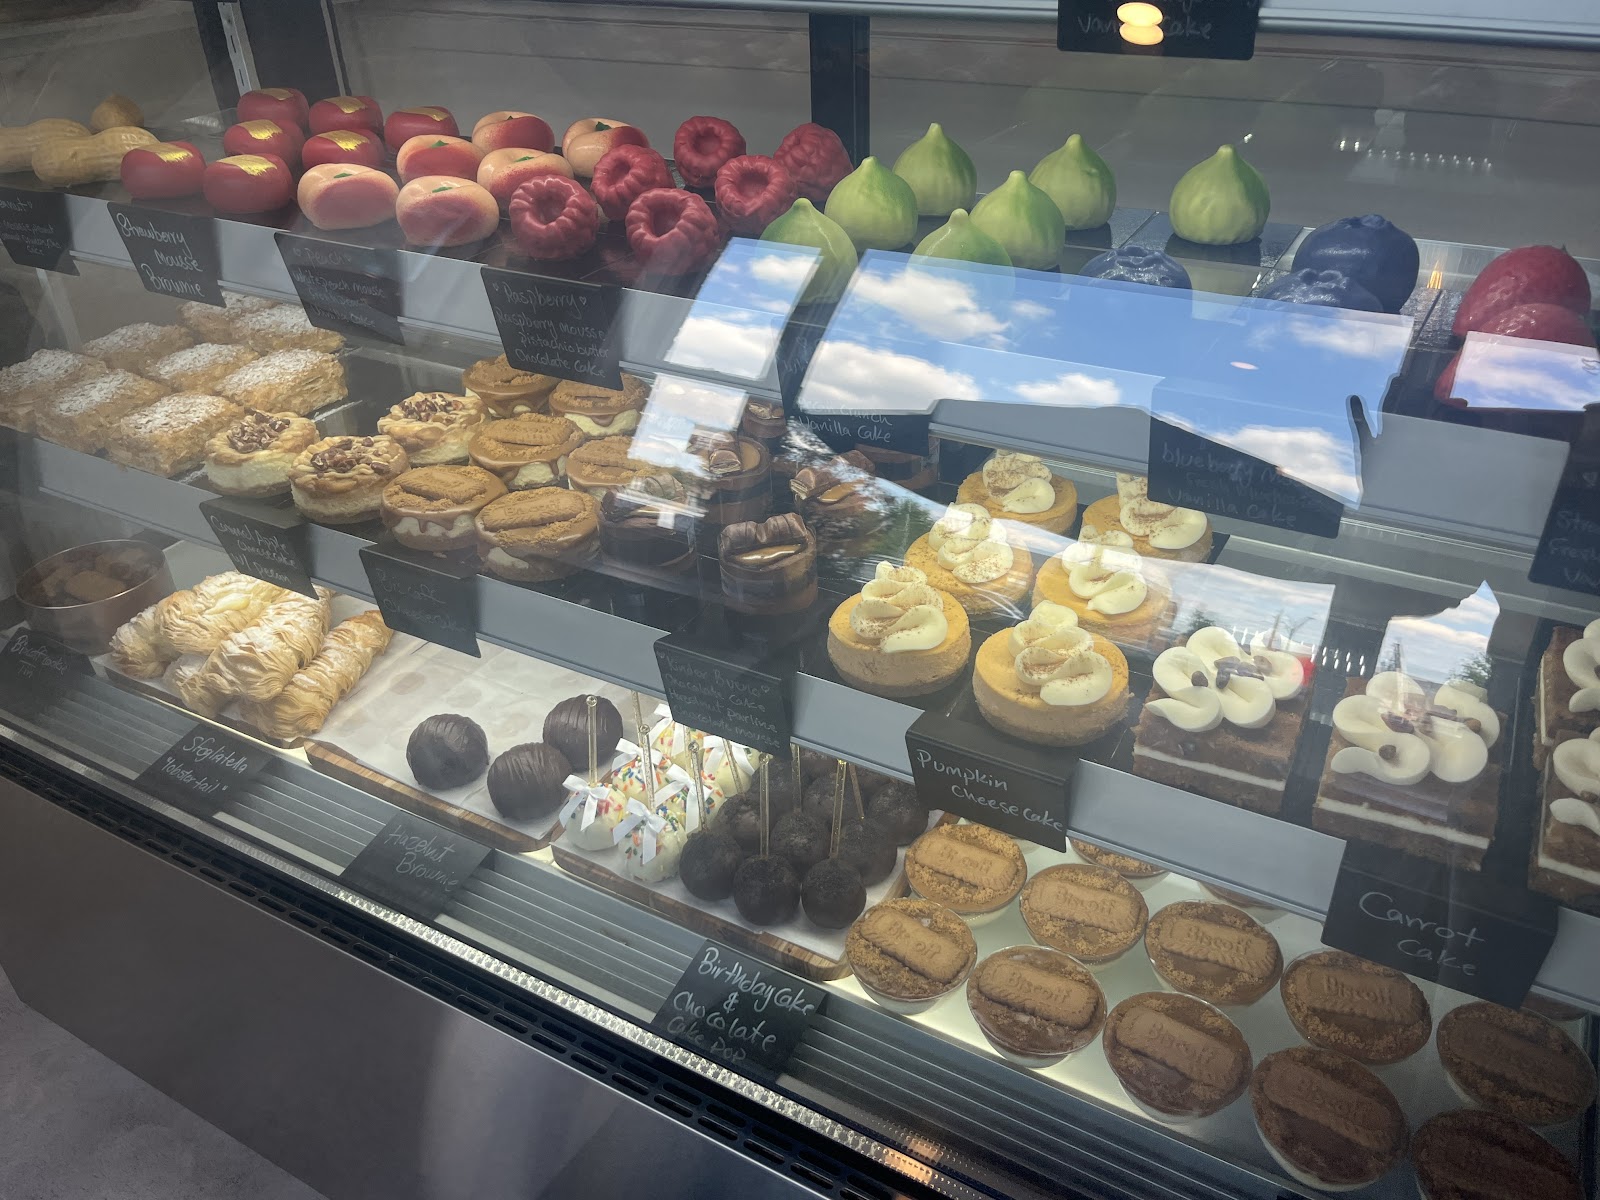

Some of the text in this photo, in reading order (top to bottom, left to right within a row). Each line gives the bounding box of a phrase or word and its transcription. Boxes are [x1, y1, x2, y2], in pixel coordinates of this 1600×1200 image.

[116, 212, 193, 260] Strawberry
[154, 248, 203, 272] Mousse
[140, 263, 205, 297] Brownie
[502, 281, 582, 320] Raspberry
[494, 306, 559, 339] Raspberry
[514, 348, 606, 378] Chocolate Cake
[798, 415, 891, 443] Vanilla Cake
[210, 515, 290, 556] Caramel Apple
[728, 694, 766, 713] Cake
[916, 748, 1008, 791] Pumpkin
[383, 824, 456, 863] Hazelnut
[395, 851, 460, 892] Brownie
[1358, 891, 1486, 948] Carrot
[1397, 939, 1478, 976] Cake
[698, 946, 816, 1017] Birthday Cake
[673, 991, 777, 1052] Chocolate
[723, 991, 740, 1014] &
[666, 1015, 705, 1044] Cake
